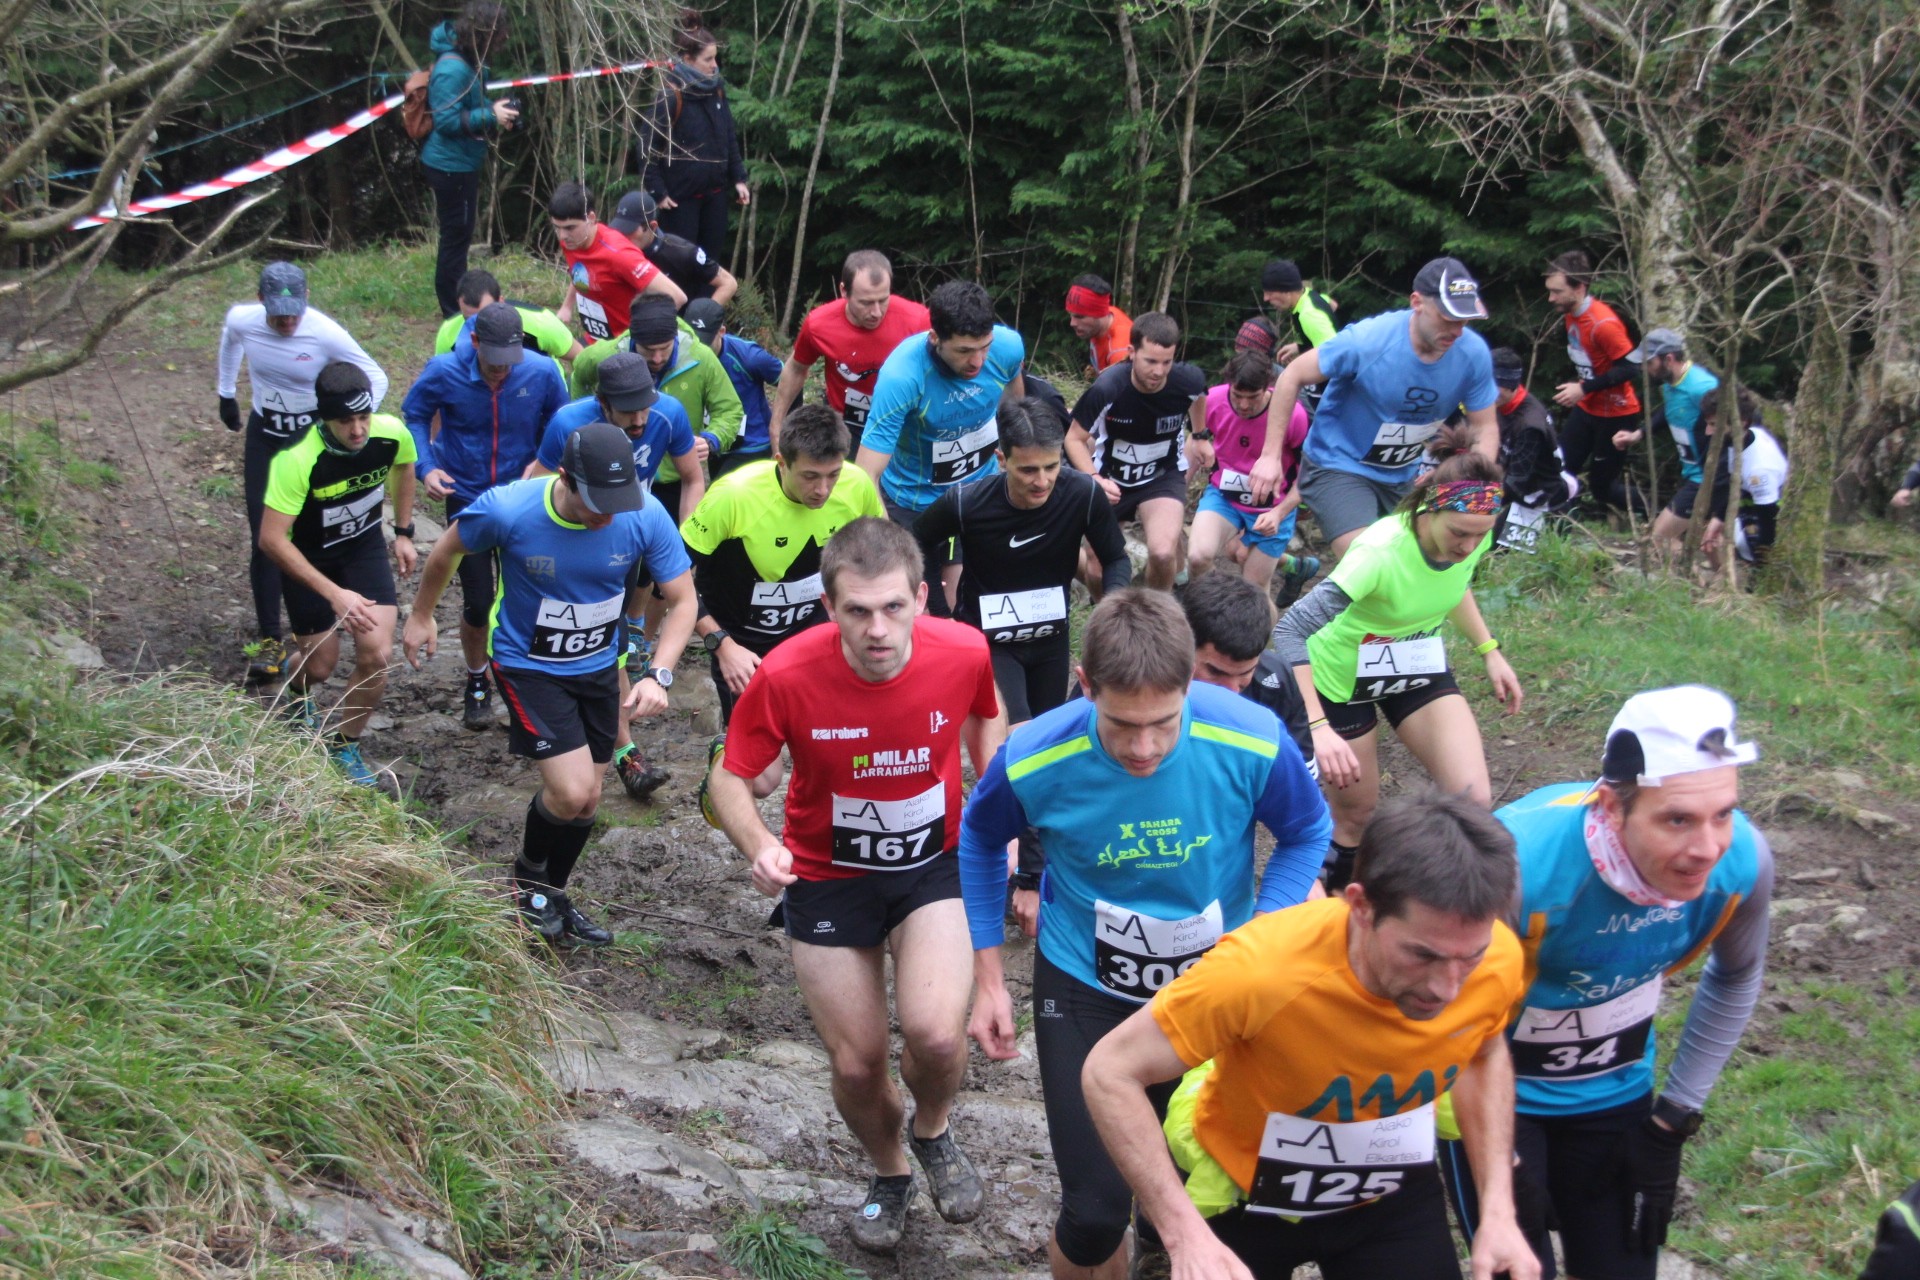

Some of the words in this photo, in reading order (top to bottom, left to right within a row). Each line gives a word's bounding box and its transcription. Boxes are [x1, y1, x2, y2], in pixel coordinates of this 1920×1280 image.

[584, 317, 608, 338] 153
[271, 414, 313, 432] 119
[1239, 436, 1250, 448] 6
[1379, 443, 1423, 463] 112
[951, 452, 980, 478] 21
[1119, 462, 1157, 481] 116
[340, 512, 370, 536] 87
[759, 604, 815, 627] 316
[546, 626, 607, 654] 165
[993, 624, 1055, 643] 256
[832, 727, 869, 739] robers
[873, 747, 931, 767] MILAR
[853, 762, 931, 779] LARRAMENDI
[904, 793, 930, 809] Aiako
[903, 806, 925, 819] Kirol
[903, 811, 938, 830] Elkartea
[1119, 823, 1136, 840] X
[1139, 818, 1182, 829] SAHARA
[1146, 827, 1178, 837] CROSS
[850, 827, 932, 861] 167
[1174, 915, 1208, 932] Aiako
[1172, 936, 1216, 955] Elkartea
[1173, 930, 1199, 944] Kirol
[1541, 1036, 1619, 1072] 34
[1372, 1116, 1413, 1133] Aiako
[1368, 1136, 1402, 1149] Kirol
[1364, 1151, 1423, 1164] Elkartea
[1280, 1170, 1405, 1204] 125
